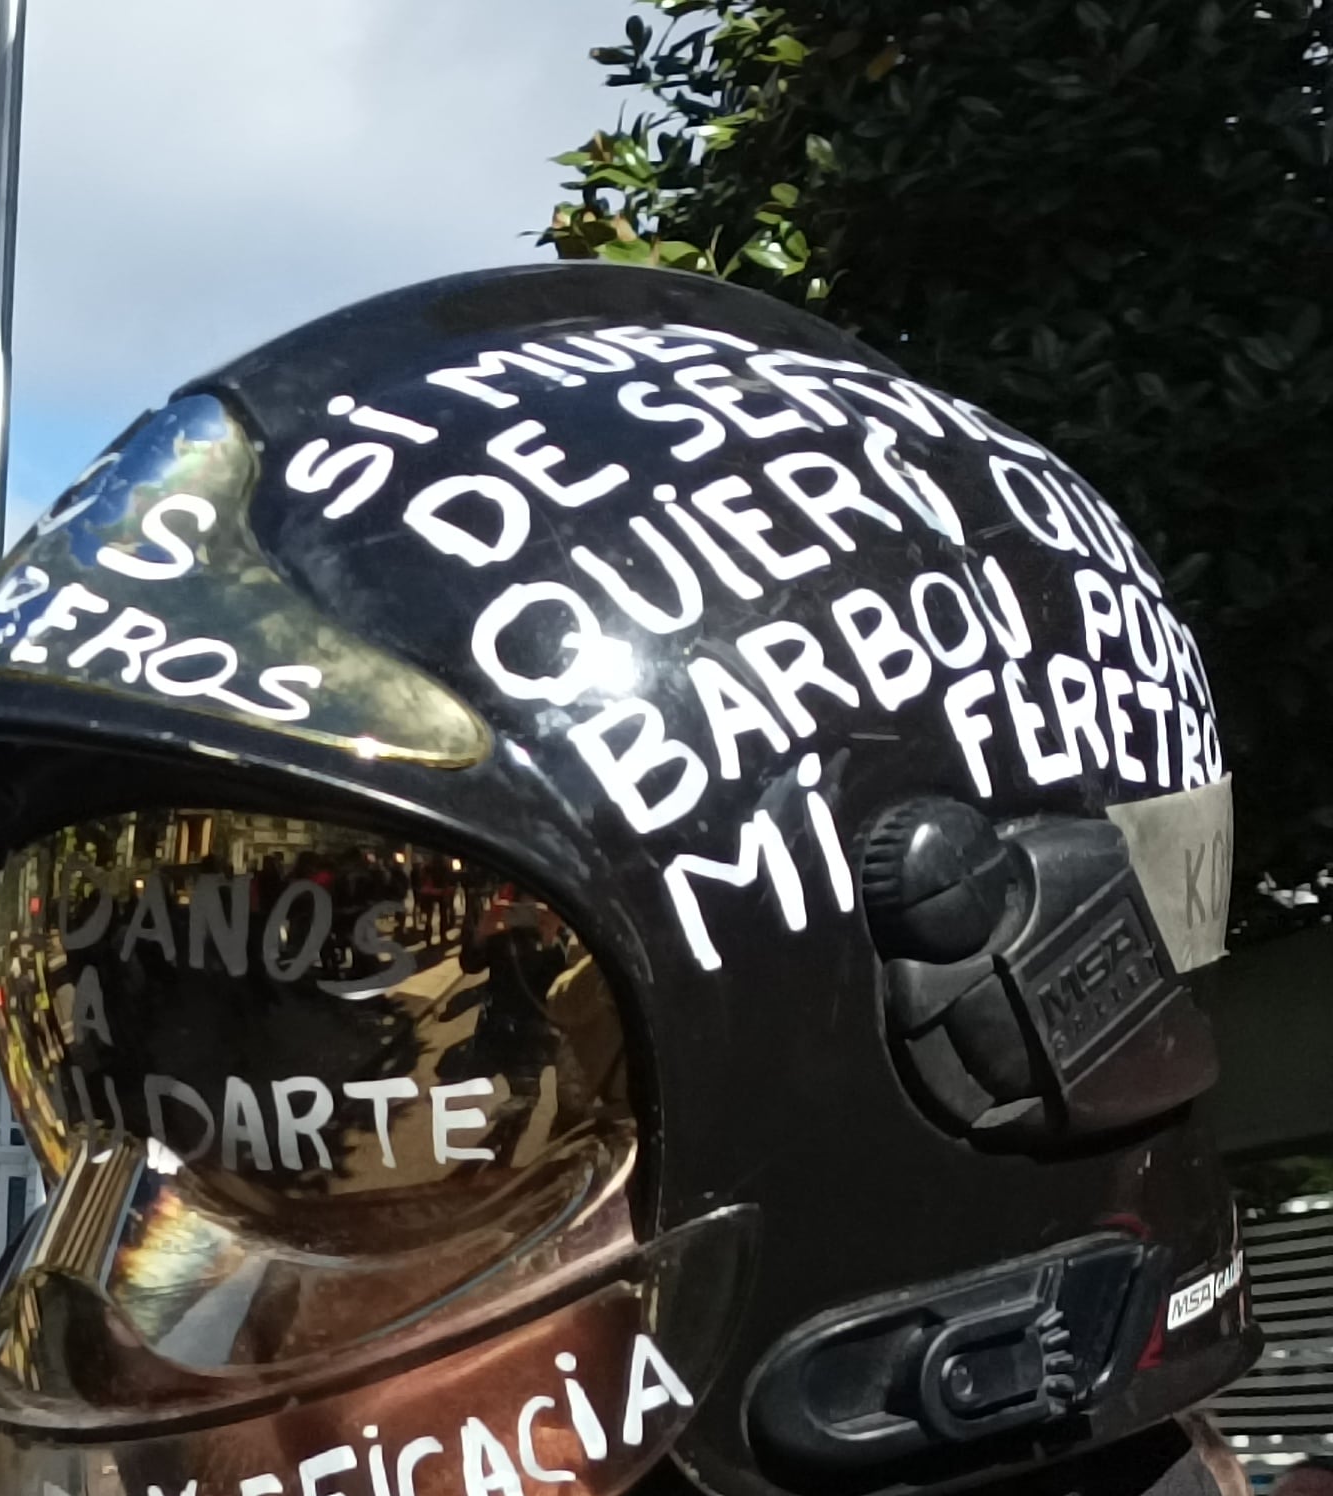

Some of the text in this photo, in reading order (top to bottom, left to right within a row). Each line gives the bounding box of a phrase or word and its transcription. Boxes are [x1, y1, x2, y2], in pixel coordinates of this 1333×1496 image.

[403, 419, 631, 568] DE
[988, 454, 1164, 598] QUE
[943, 653, 1223, 798] FERETRO
[1037, 918, 1133, 1027] MSA
[1171, 1282, 1212, 1322] MSA
